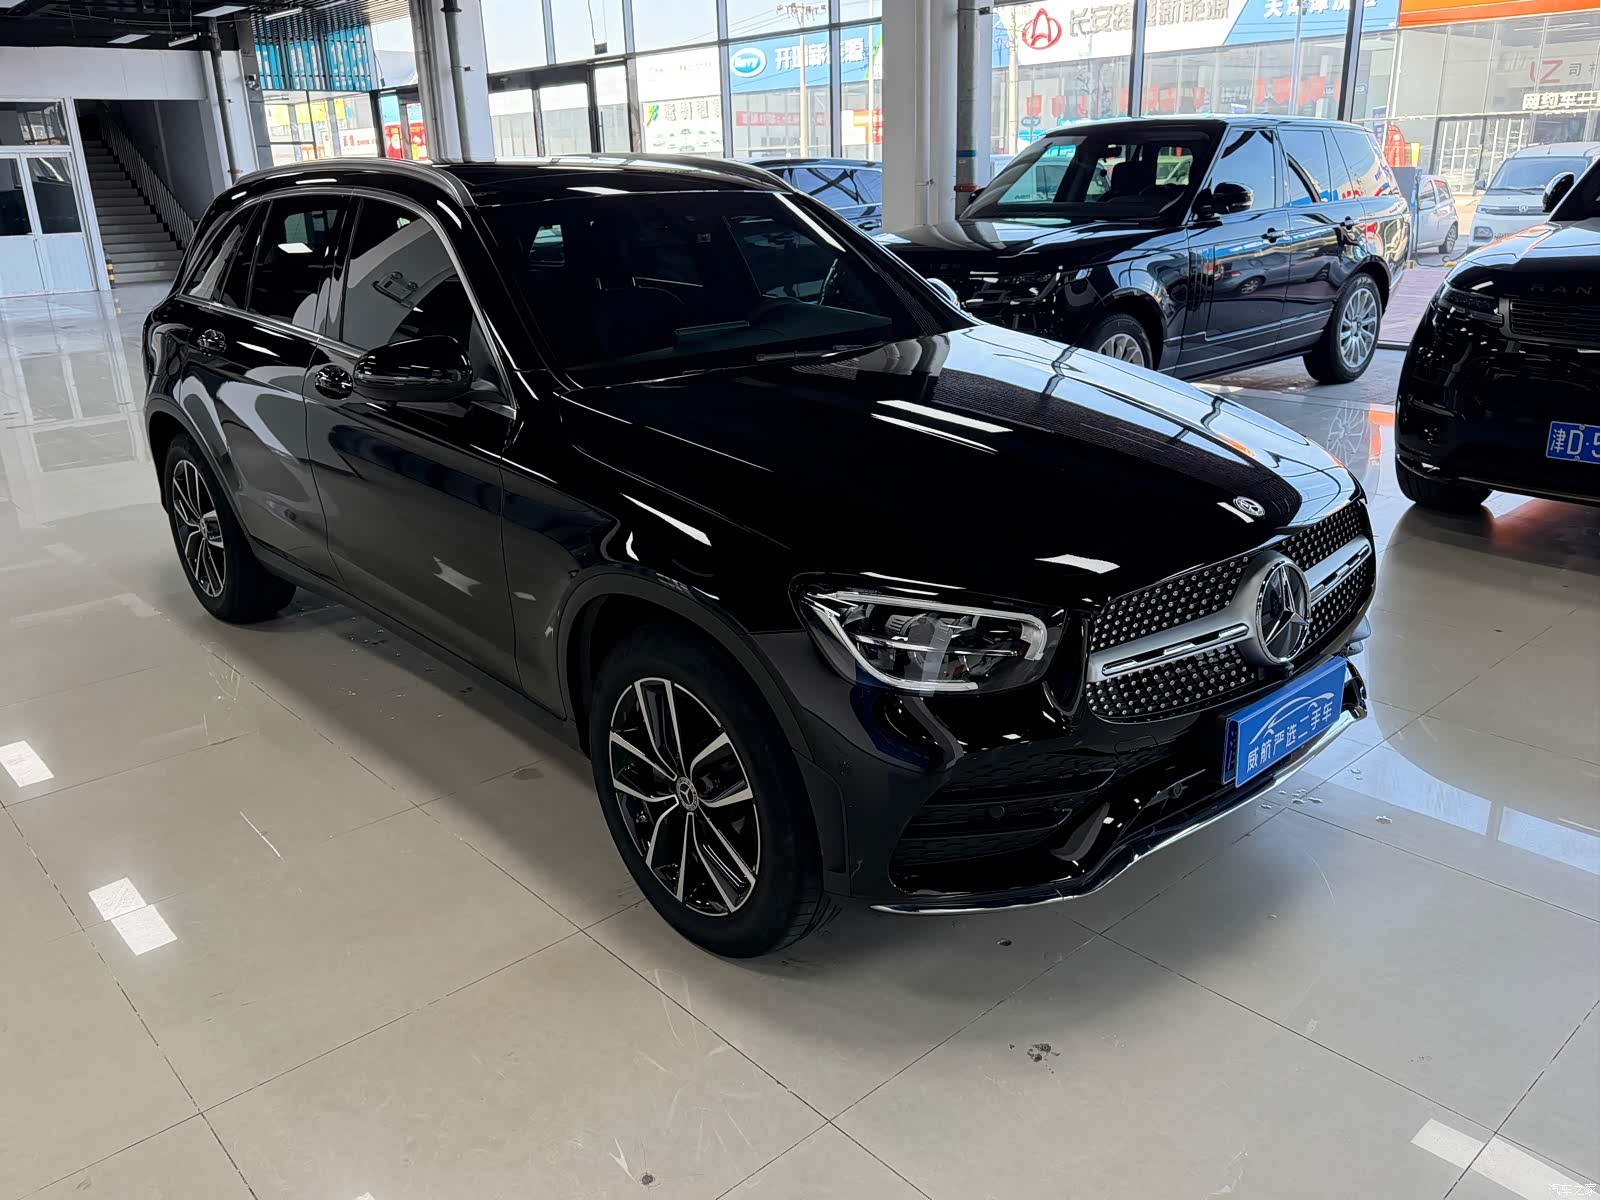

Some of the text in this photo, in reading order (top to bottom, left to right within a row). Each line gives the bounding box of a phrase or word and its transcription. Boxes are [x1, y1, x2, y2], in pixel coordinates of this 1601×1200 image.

[1246, 701, 1334, 773] 威航严选二手车
